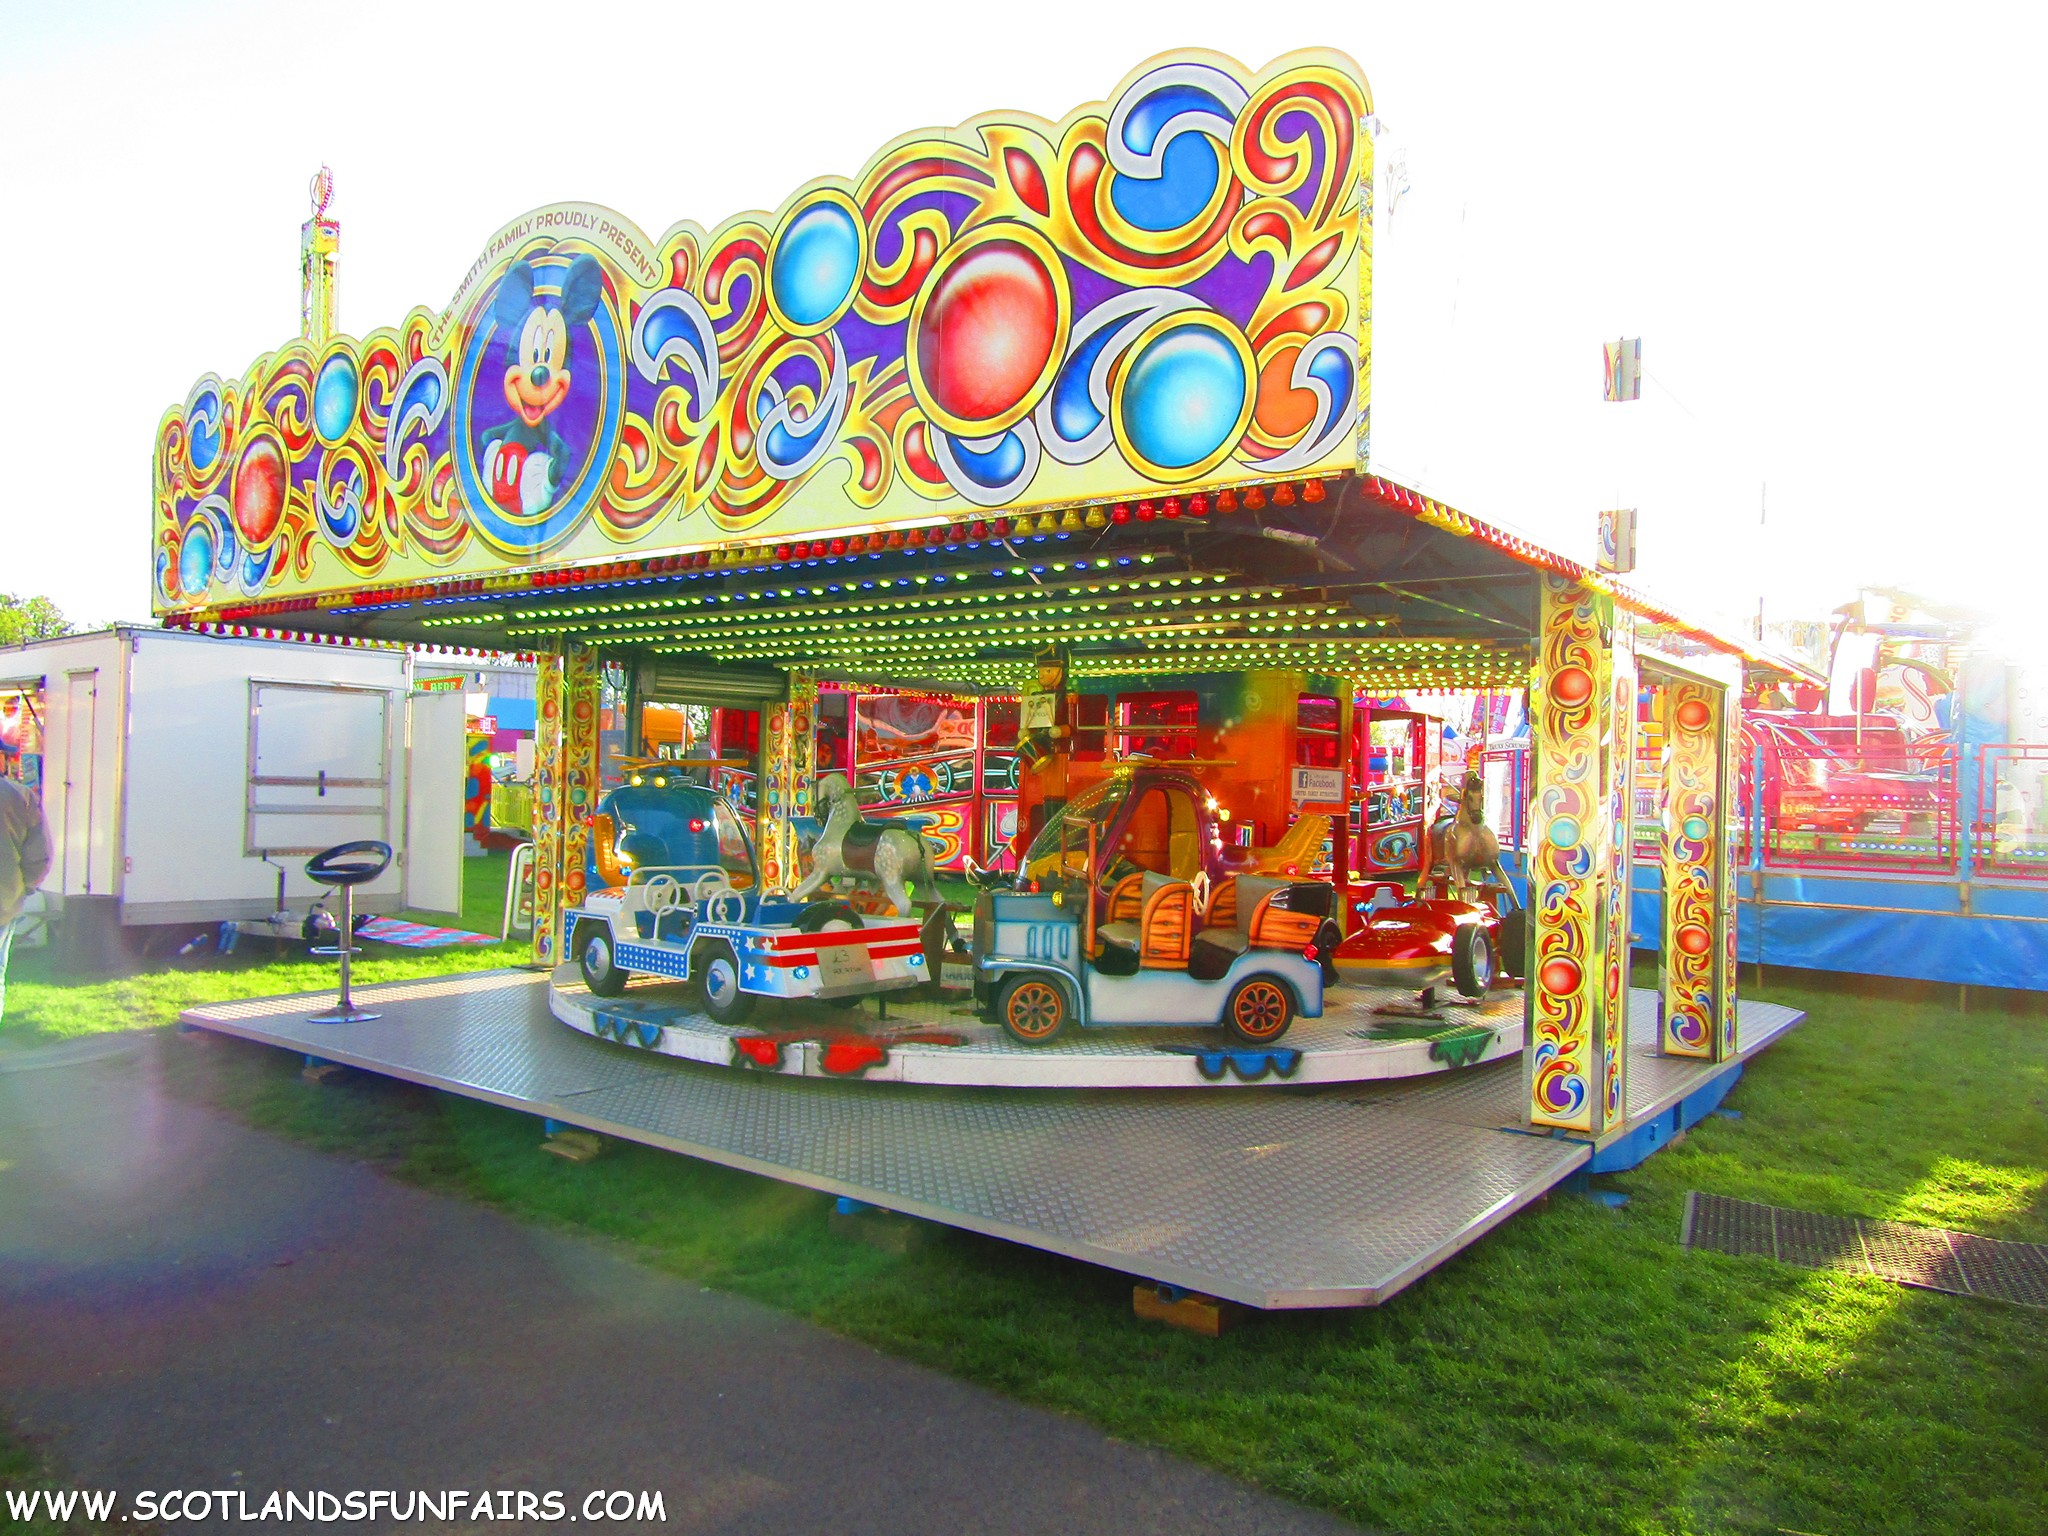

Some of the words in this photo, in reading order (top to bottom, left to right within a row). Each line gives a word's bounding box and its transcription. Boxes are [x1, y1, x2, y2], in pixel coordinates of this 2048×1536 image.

[432, 310, 453, 343] THE
[453, 252, 488, 305] SMITH
[489, 219, 533, 258] FAMILY
[536, 211, 599, 230] PROUDLY
[599, 220, 657, 282] PRESENT
[1309, 779, 1336, 788] Facebook
